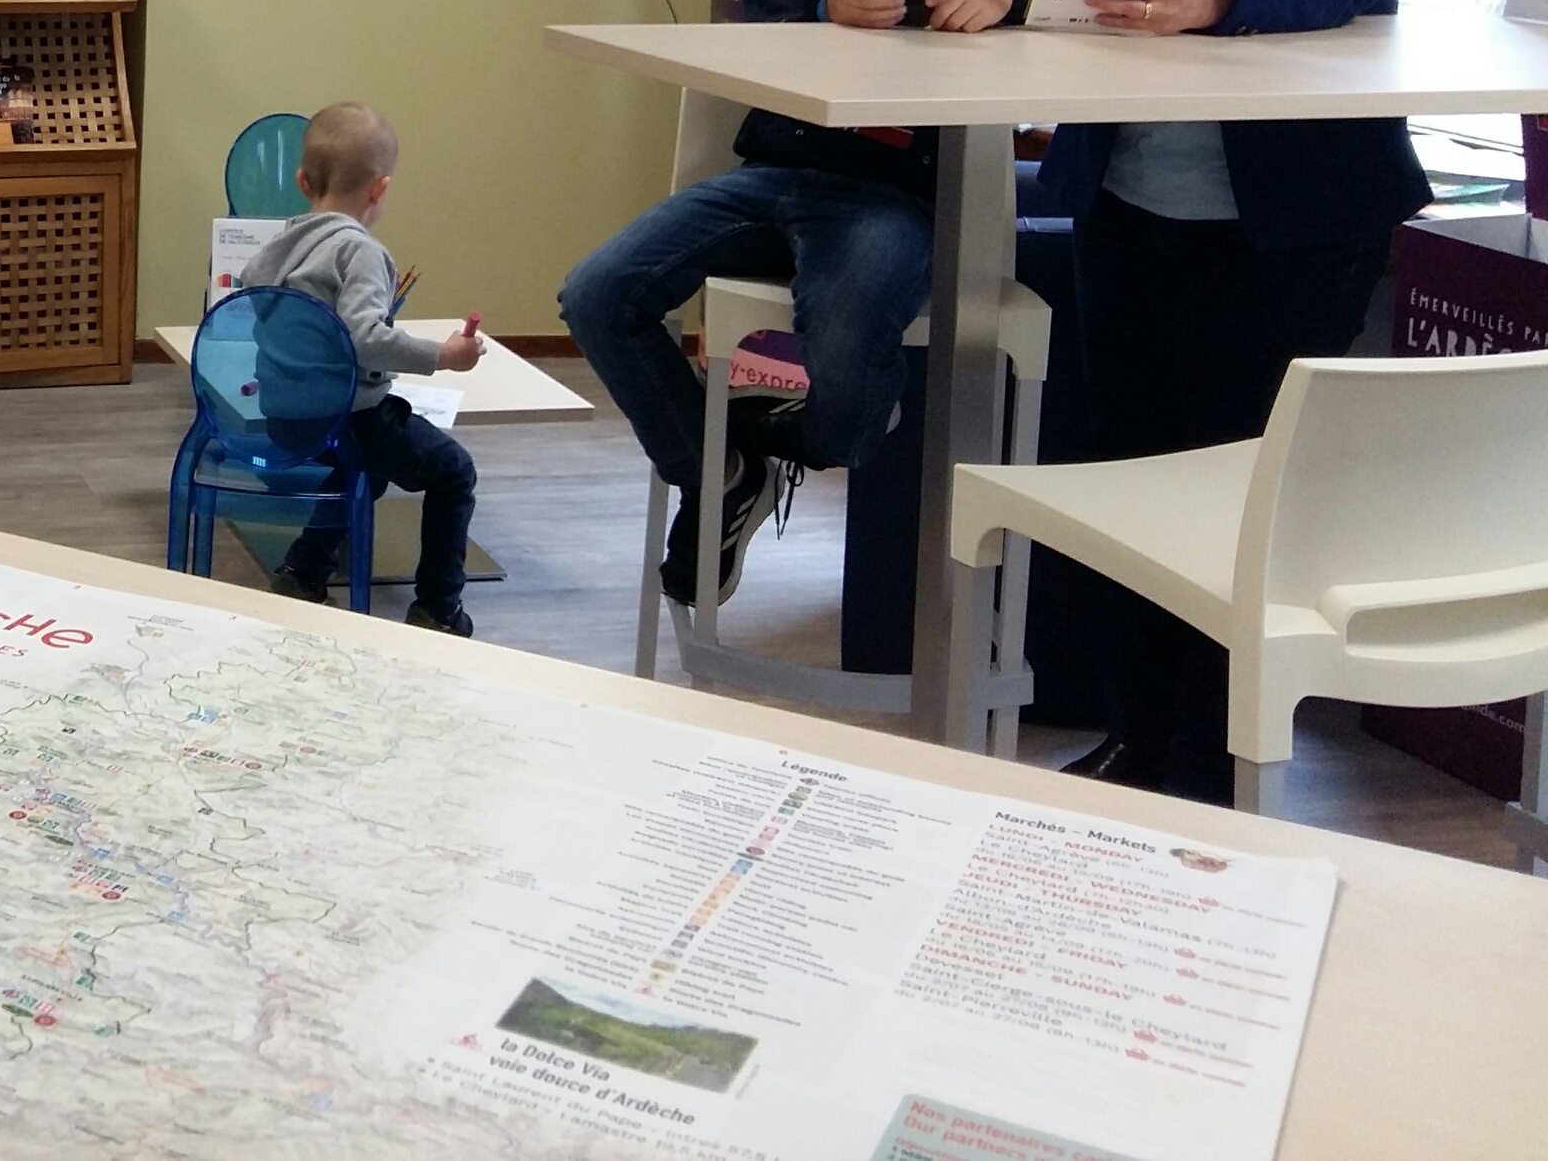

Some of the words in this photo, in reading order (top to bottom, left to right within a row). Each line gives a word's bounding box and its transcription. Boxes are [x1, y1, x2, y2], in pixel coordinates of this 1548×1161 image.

[1409, 287, 1515, 336] ÉMERVEILLÉS
[1406, 317, 1513, 358] L'ARDÈ
[780, 759, 849, 783] Légende
[988, 823, 1045, 842] LUNDI
[1063, 840, 1144, 863] MONDAY
[994, 809, 1068, 835] Marchés
[1086, 829, 1158, 855] Markets
[971, 853, 1070, 883] MERCREDI
[1089, 880, 1212, 915] WEDNESDAY
[1041, 888, 1144, 918] THURSDAY
[935, 918, 1036, 948] VENDREDI
[1056, 946, 1130, 970] FRIDAY
[919, 943, 1028, 976] DIMANCHE
[1050, 973, 1134, 1002] SUNDAY
[500, 1037, 519, 1053] la
[521, 1042, 576, 1071] Dolce
[581, 1061, 612, 1083] Via
[489, 1055, 529, 1075] voie
[531, 1068, 592, 1095] douce
[594, 1087, 697, 1127] d'Ardèche
[902, 1114, 937, 1135] Our
[909, 1099, 947, 1123] Nos
[950, 1116, 1066, 1158] partenaires
